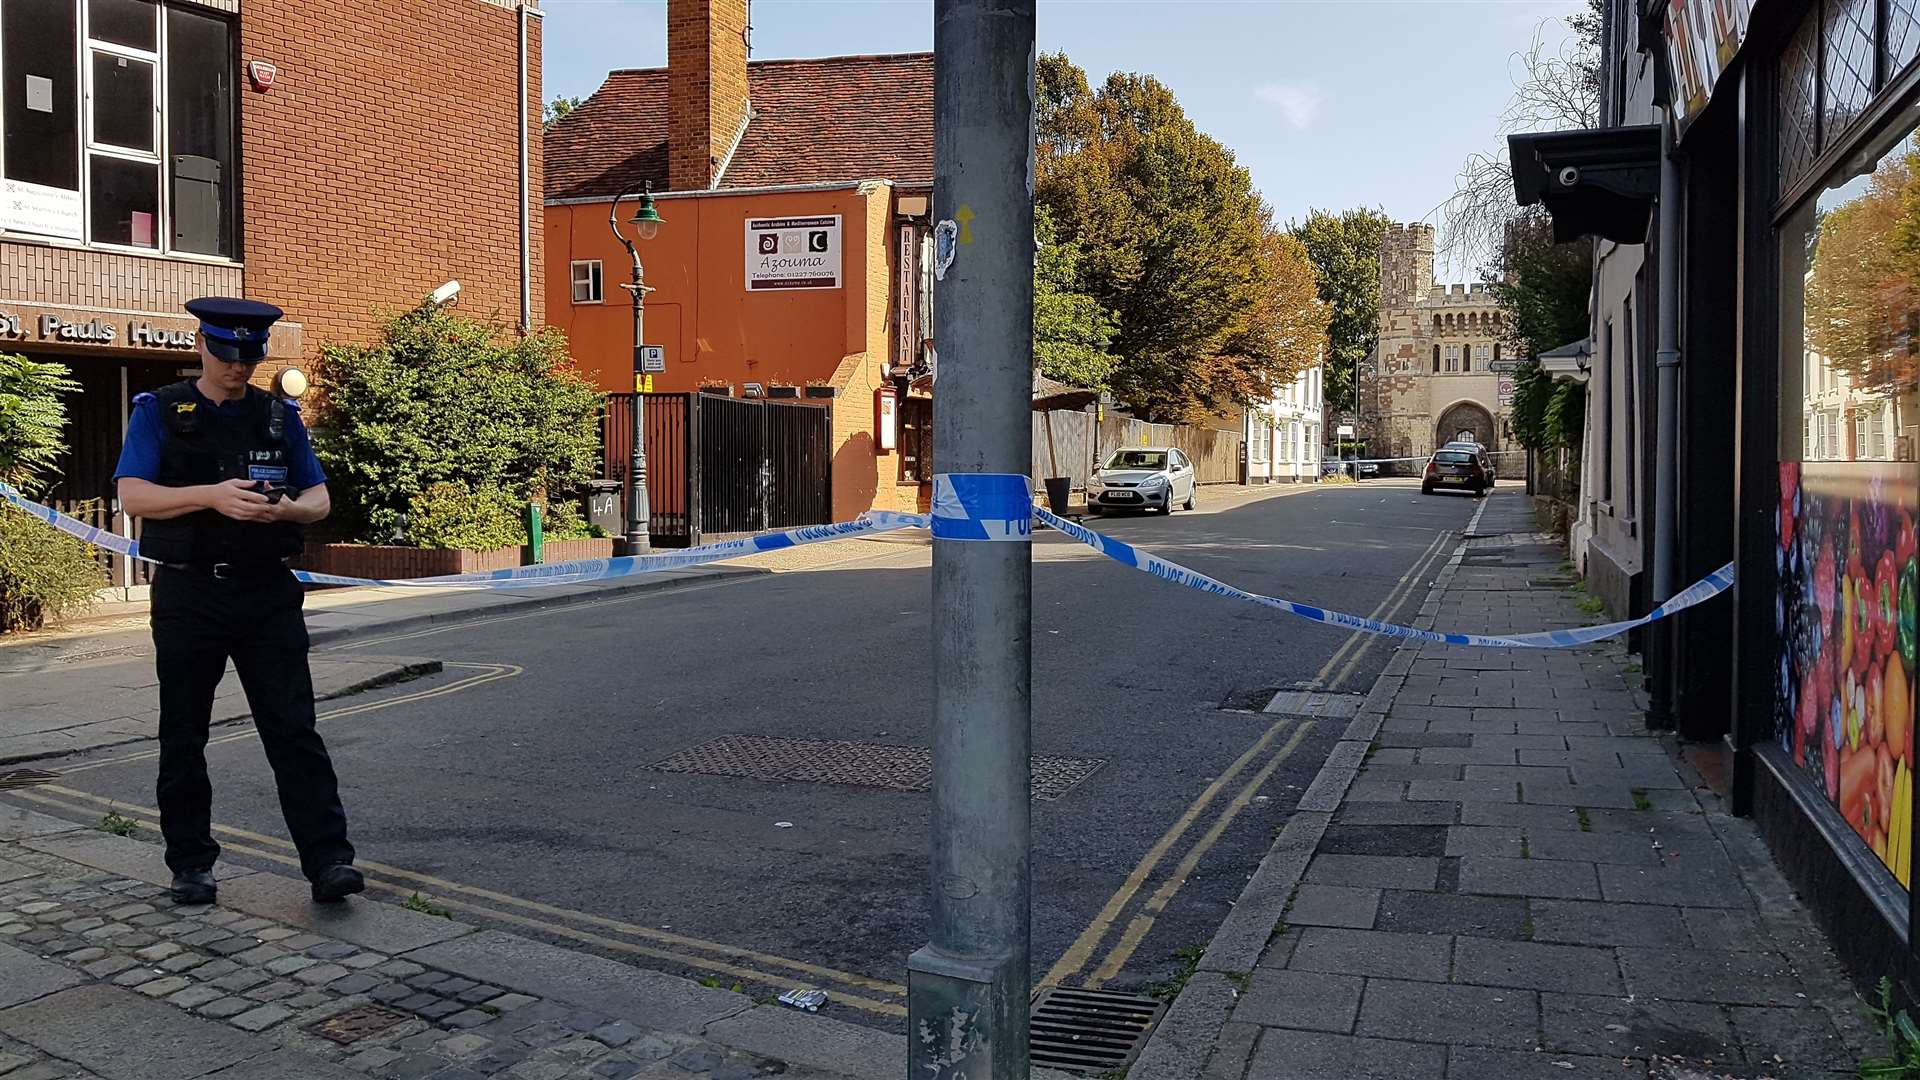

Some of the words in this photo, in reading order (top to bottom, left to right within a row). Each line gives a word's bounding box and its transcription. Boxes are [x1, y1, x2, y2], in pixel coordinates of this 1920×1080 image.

[760, 256, 826, 272] Azouma
[902, 231, 910, 361] RESTAURANT
[41, 313, 117, 343] Pauls
[131, 319, 197, 349] Hous
[593, 496, 613, 517] 4A
